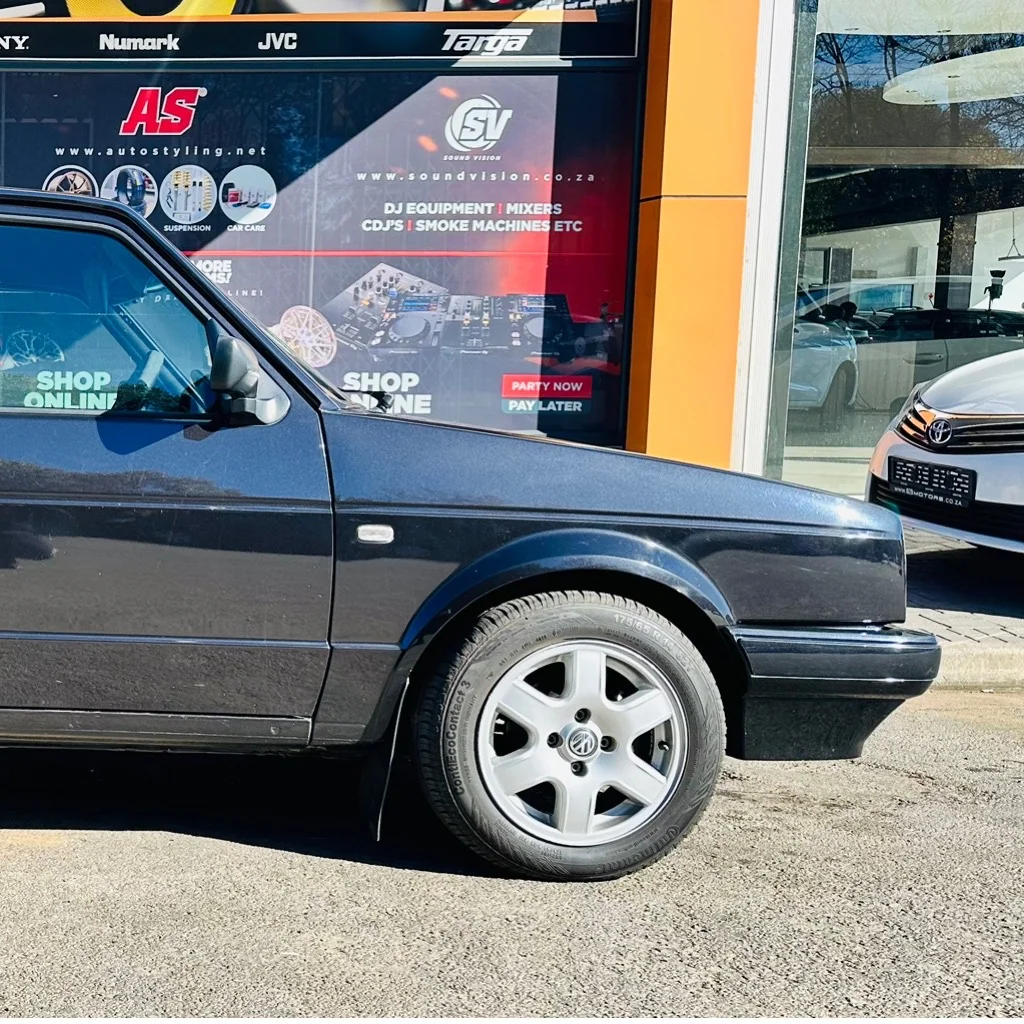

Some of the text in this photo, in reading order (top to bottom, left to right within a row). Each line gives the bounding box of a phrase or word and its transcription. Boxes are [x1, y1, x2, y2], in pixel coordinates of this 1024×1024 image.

[99, 33, 180, 50] Numark
[258, 33, 297, 50] JVC
[441, 29, 533, 56] Targa
[119, 87, 202, 135] AS
[55, 145, 267, 156] www.autostyling.net
[357, 170, 595, 181] www.soundvision.co.za
[384, 203, 562, 215] DJ EQUIPMENT MIXERS
[163, 224, 211, 232] SUSPENSION
[227, 224, 265, 232] CAR CARE
[361, 219, 583, 232] CDJ'S SMOKE MACHINES ETC
[36, 370, 111, 390] SHOP
[342, 371, 420, 393] SHOP
[511, 381, 583, 392] PARTY NOW
[509, 400, 582, 412] PAY LATER
[613, 613, 651, 634] 175/65
[652, 630, 661, 640] R
[461, 680, 472, 689] 3
